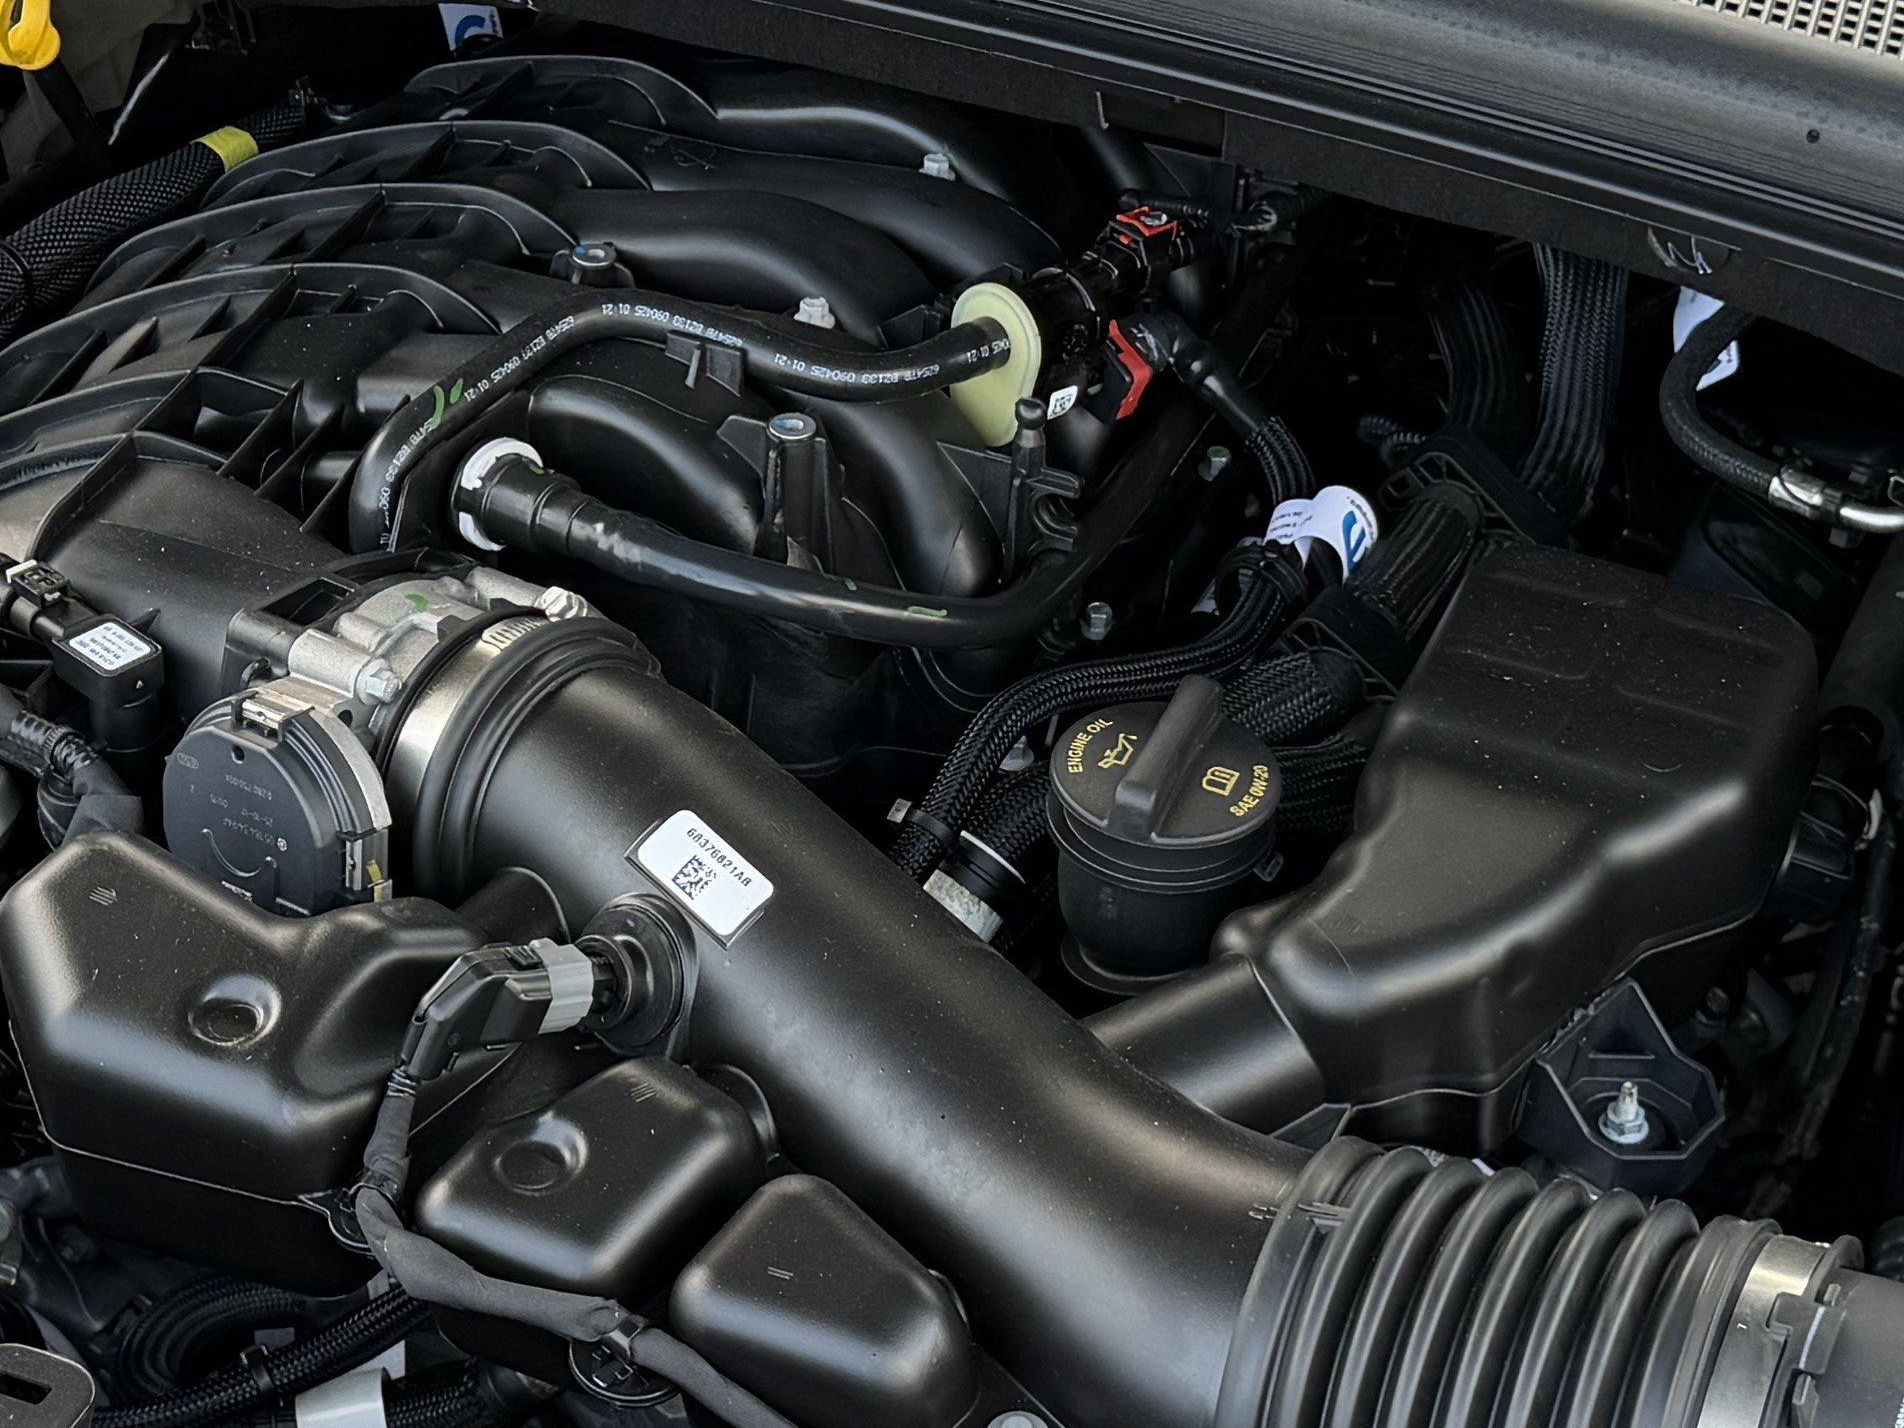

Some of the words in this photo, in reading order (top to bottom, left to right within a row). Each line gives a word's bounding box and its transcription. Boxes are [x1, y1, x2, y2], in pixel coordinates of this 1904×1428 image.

[1067, 732, 1093, 773] ENGINE
[1086, 718, 1114, 733] OIL
[1229, 794, 1260, 817] SAE
[1249, 765, 1269, 797] 0W-20
